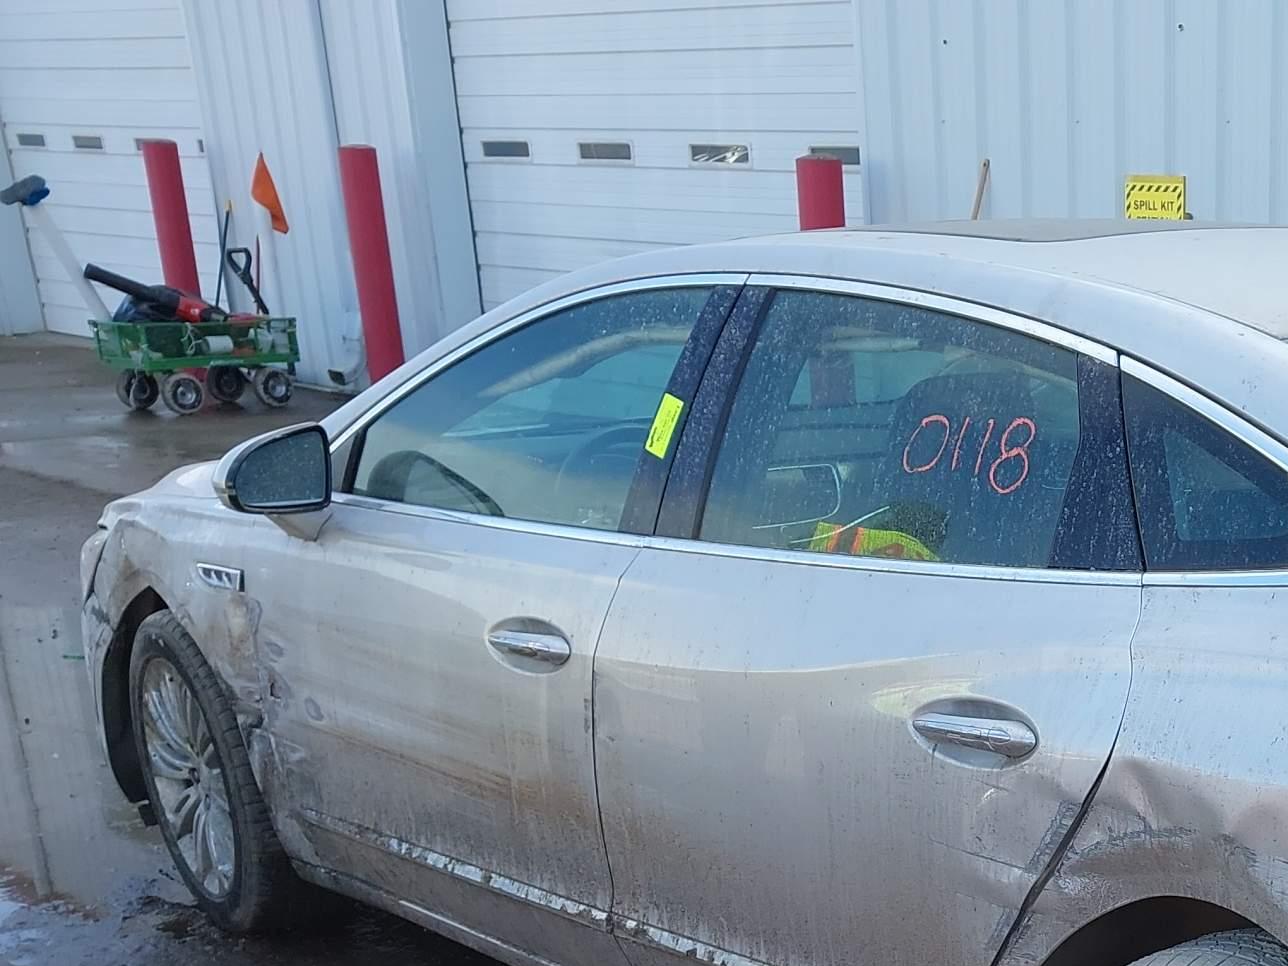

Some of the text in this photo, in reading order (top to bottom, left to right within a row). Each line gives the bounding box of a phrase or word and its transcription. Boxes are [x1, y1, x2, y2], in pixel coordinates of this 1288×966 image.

[1133, 199, 1175, 212] SPILL KIT
[902, 414, 1037, 495] 0118
